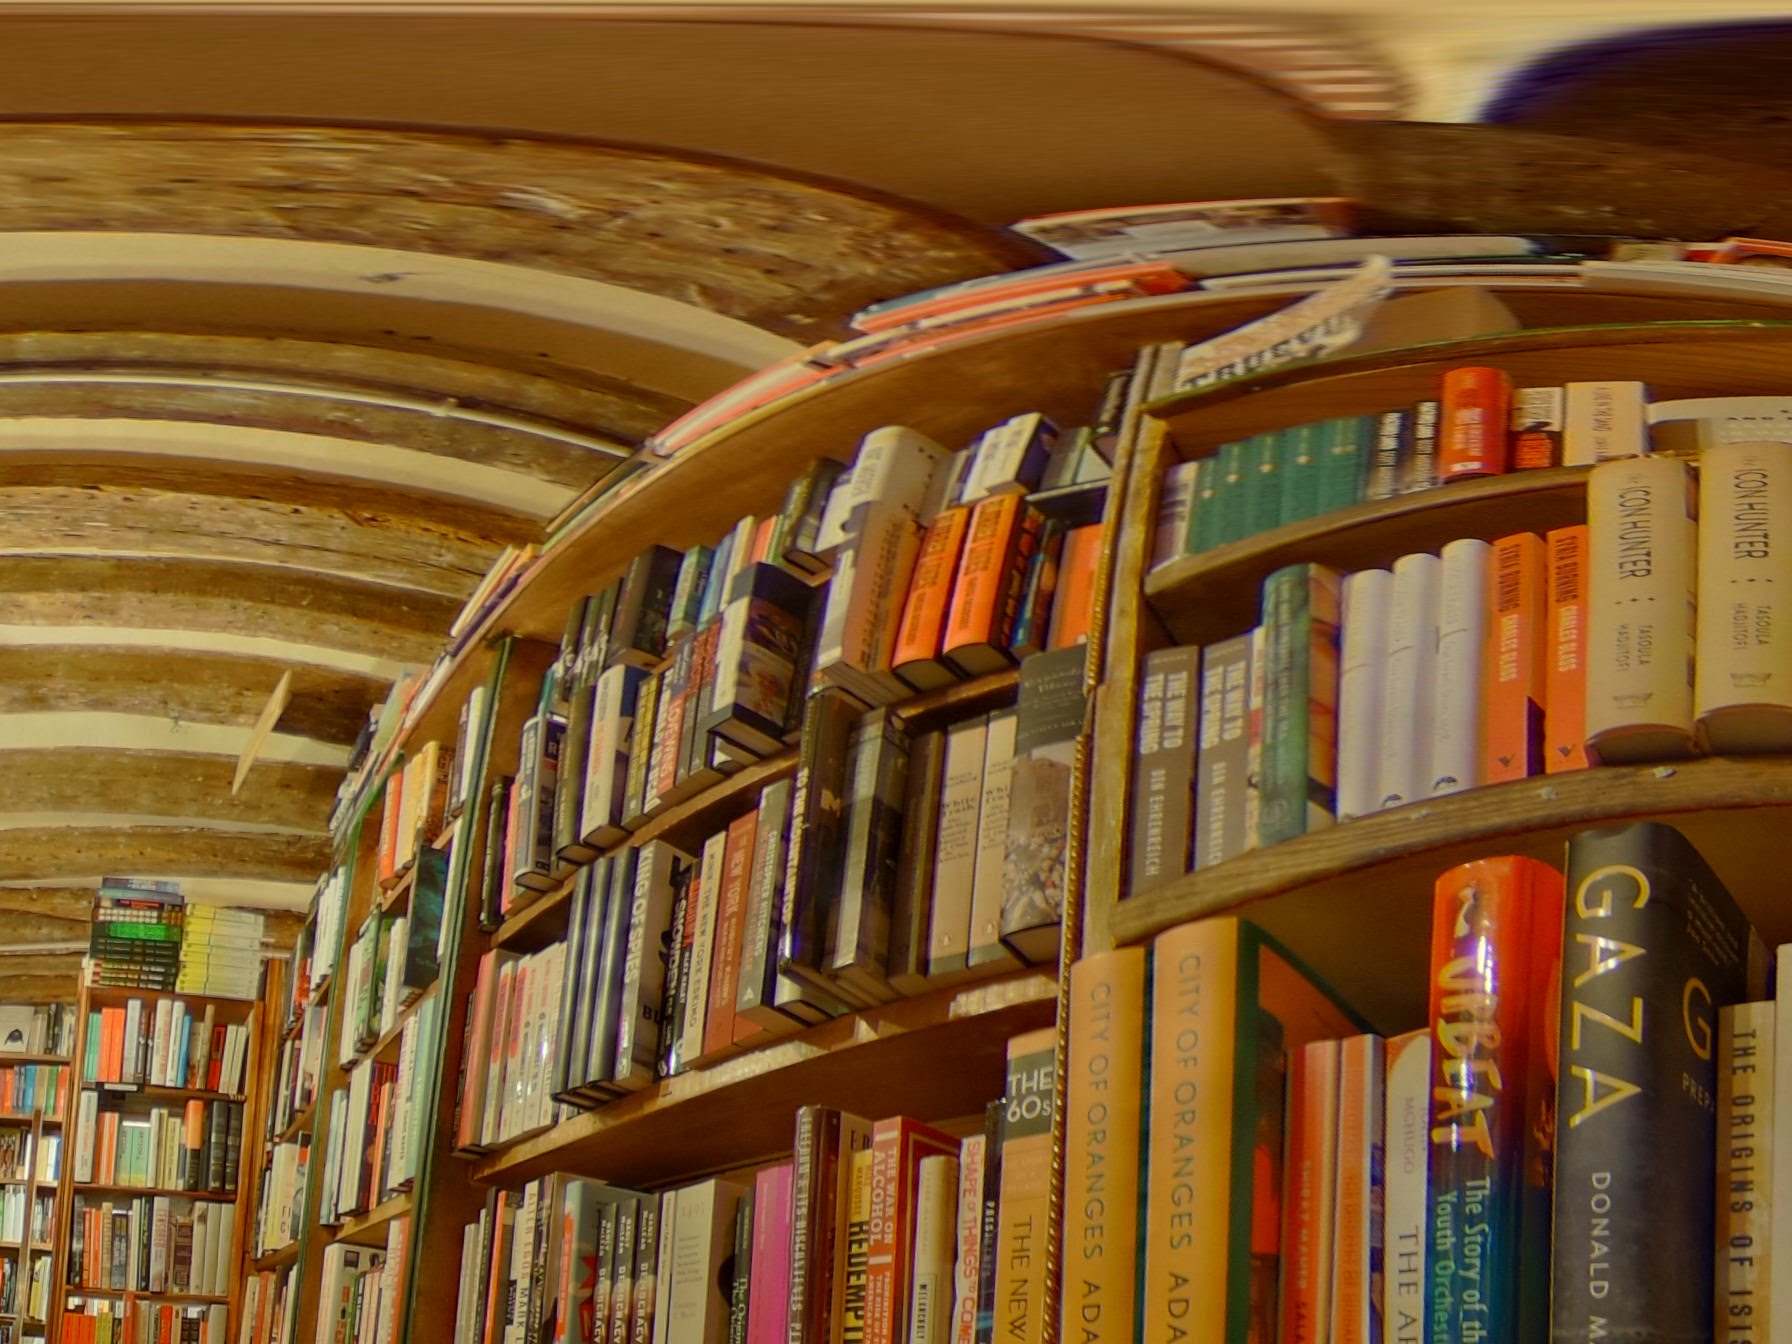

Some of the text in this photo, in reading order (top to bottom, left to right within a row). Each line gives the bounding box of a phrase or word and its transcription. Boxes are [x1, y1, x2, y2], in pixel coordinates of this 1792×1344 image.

[1734, 501, 1768, 559] HUNTER
[1090, 981, 1111, 1050] CITY
[1180, 953, 1203, 1027] CITY
[1568, 863, 1652, 1131] GAZA
[1007, 1066, 1053, 1097] THE
[1731, 1028, 1757, 1076] THE
[1080, 1103, 1106, 1262] ORANGES
[1169, 1082, 1199, 1265] ORANGES
[1729, 1092, 1756, 1215] ORIGINS
[868, 1152, 887, 1247] ALCOHOL
[1435, 1191, 1459, 1251] Youth
[1464, 1178, 1490, 1215] The
[1013, 1215, 1032, 1259] THE
[1458, 1223, 1487, 1281] Story
[1588, 1170, 1612, 1299] DONALD
[1729, 1235, 1753, 1269] OF
[1008, 1266, 1031, 1336] NEW
